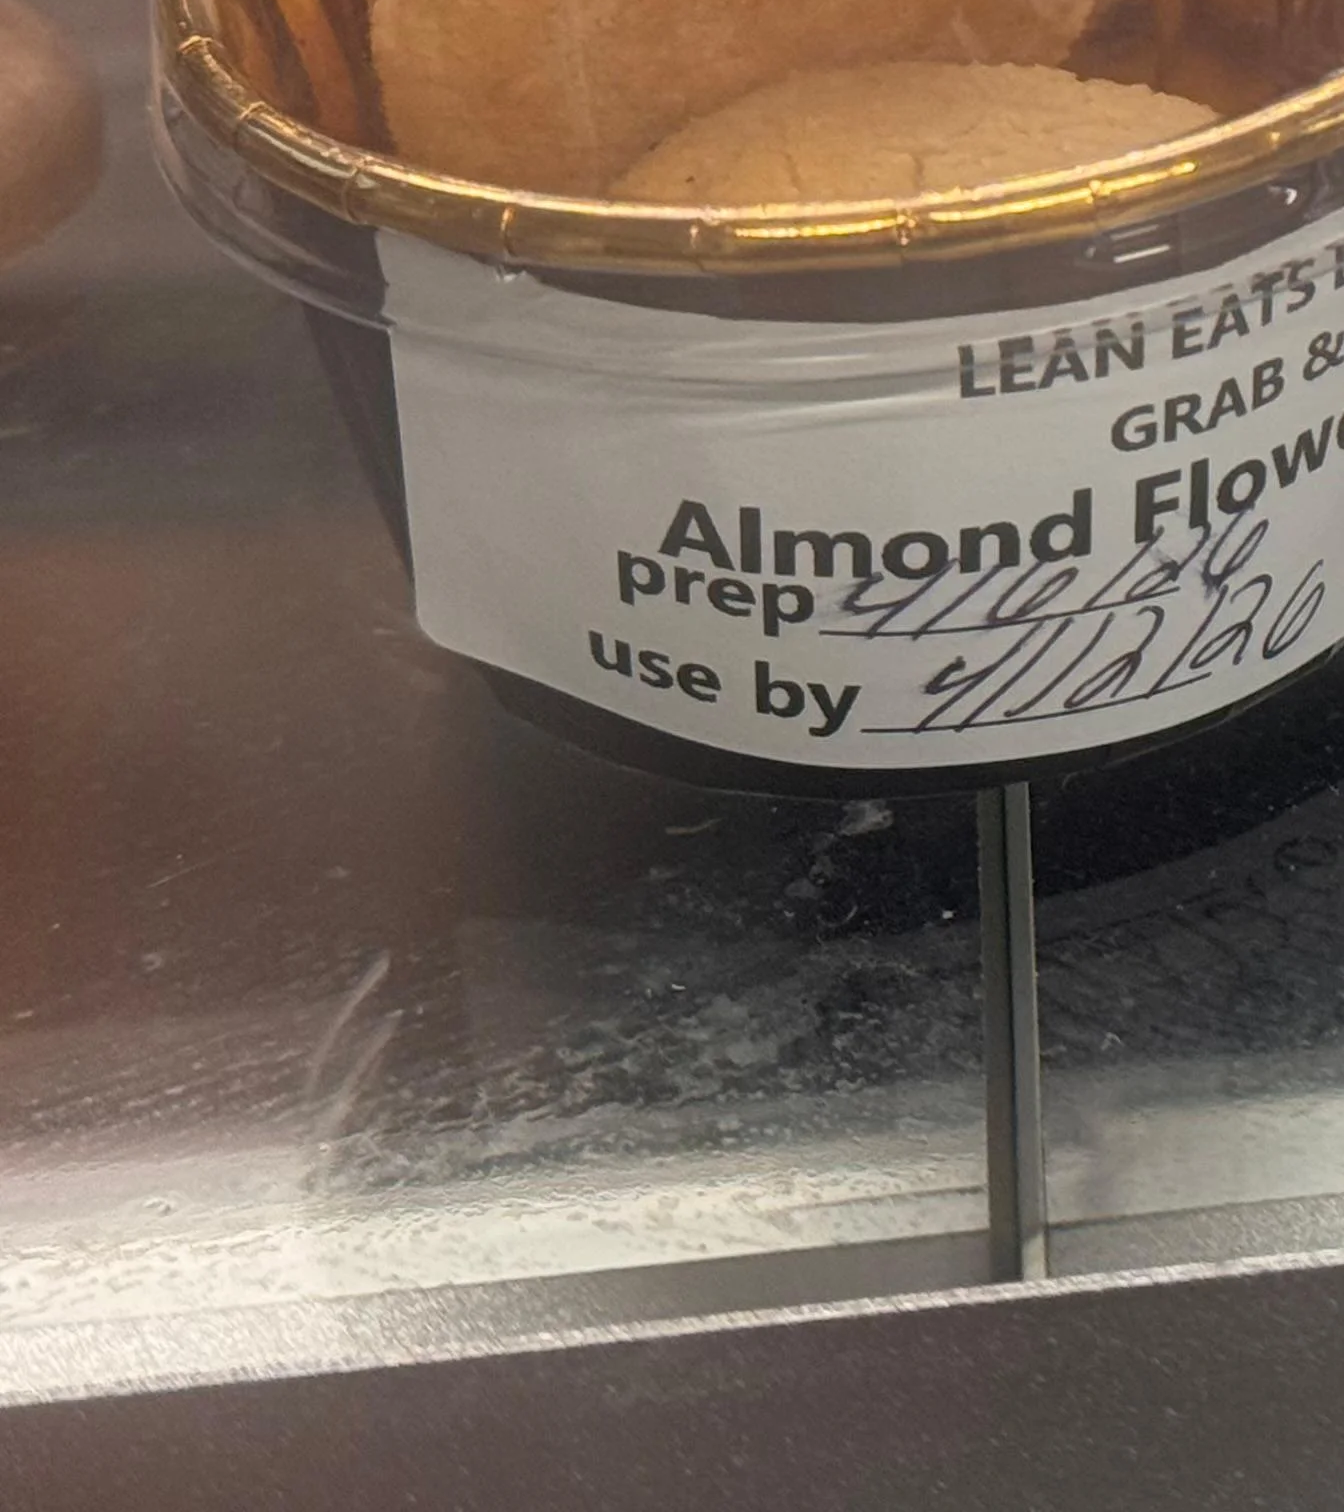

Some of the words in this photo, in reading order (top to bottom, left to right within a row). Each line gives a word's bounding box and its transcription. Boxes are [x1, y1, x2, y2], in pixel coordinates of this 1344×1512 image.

[957, 313, 1147, 399] LEAN
[1172, 256, 1316, 359] EATS
[1111, 357, 1285, 452] GRAB
[658, 491, 1094, 581] Almond
[617, 549, 815, 637] prep
[588, 629, 721, 703] use
[755, 662, 862, 737] by
